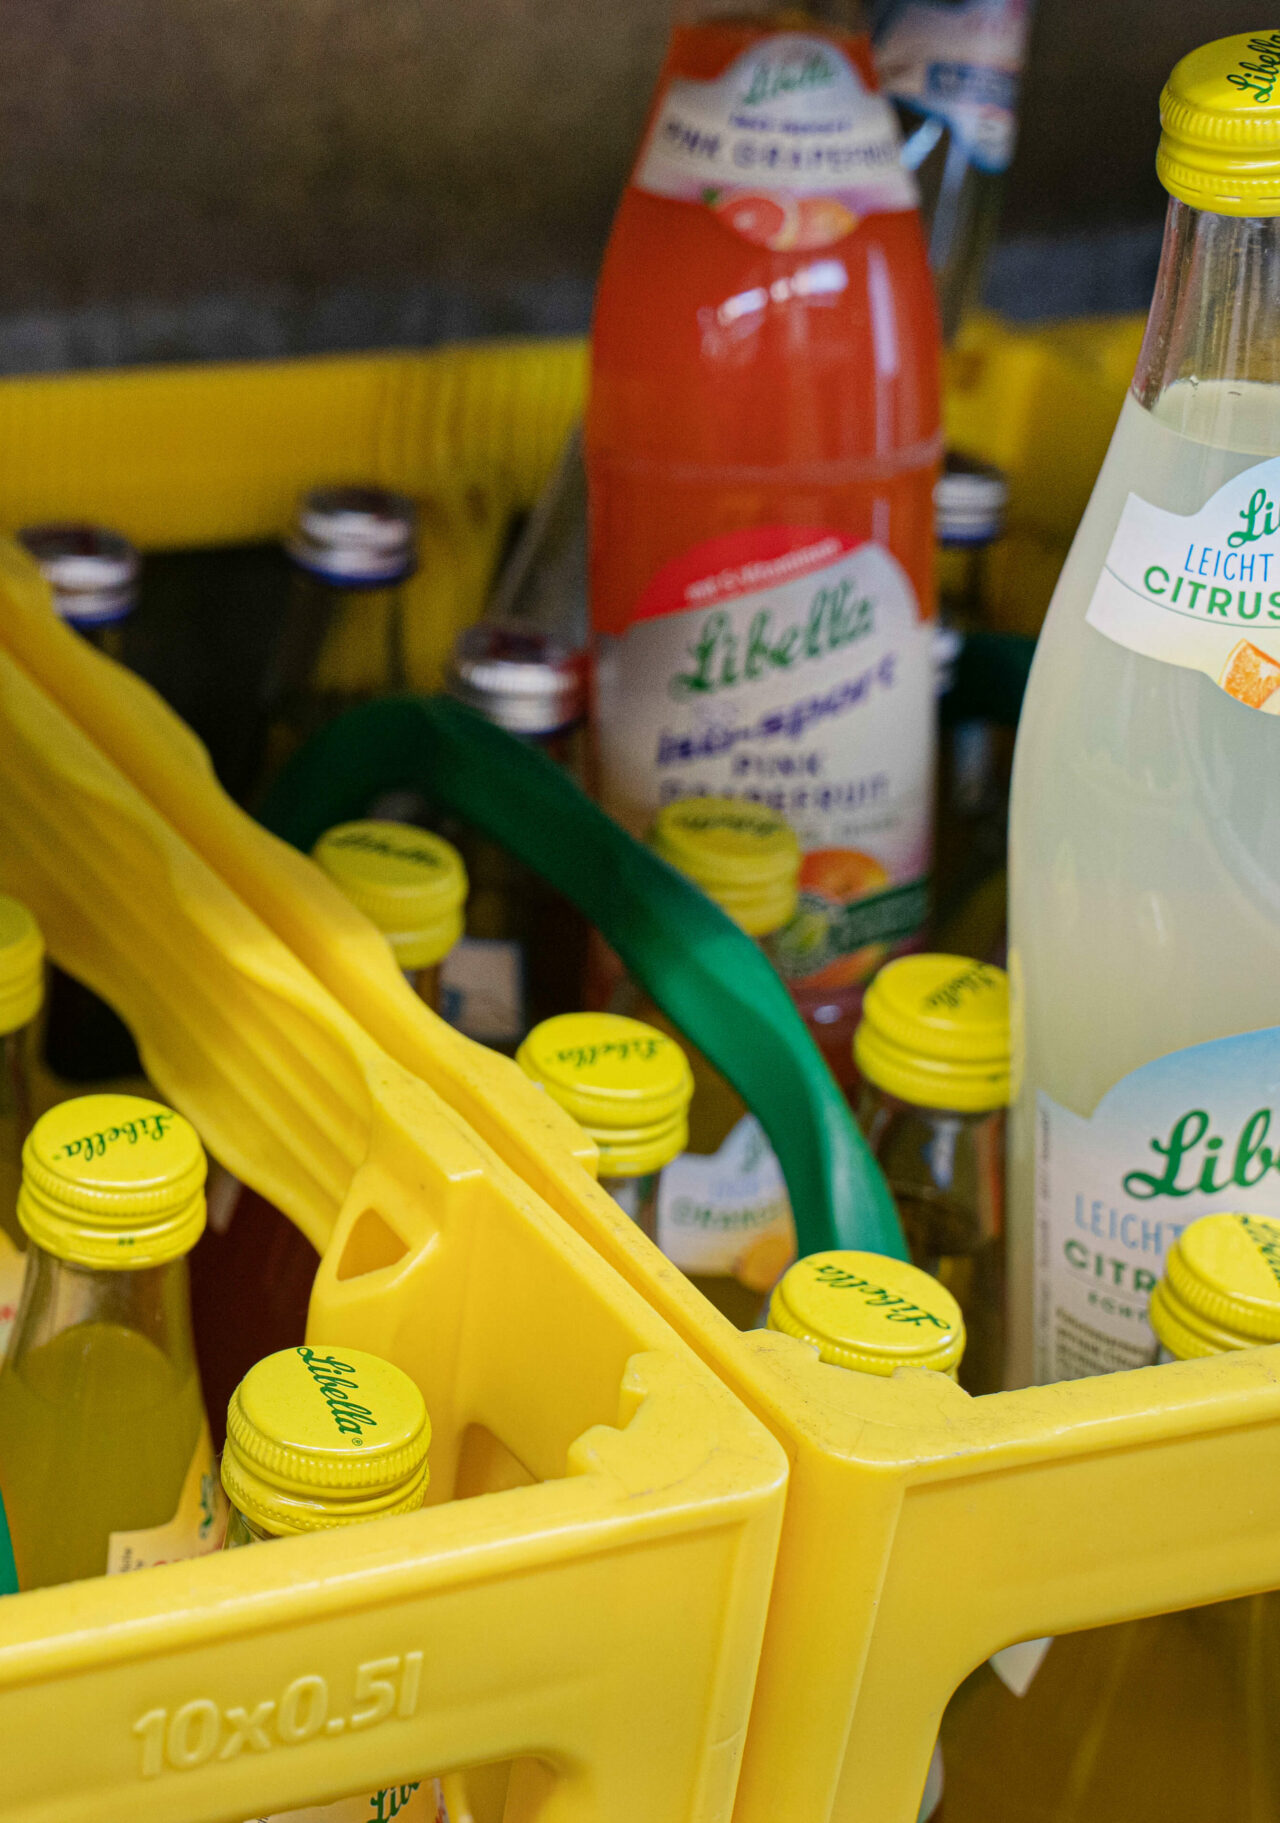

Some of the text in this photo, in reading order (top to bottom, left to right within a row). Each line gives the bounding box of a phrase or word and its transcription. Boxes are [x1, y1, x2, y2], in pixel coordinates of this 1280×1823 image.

[1184, 544, 1274, 582] LEICHT
[63, 1111, 173, 1162] Libella
[815, 1265, 951, 1330] Libella
[297, 1347, 377, 1435] Libella
